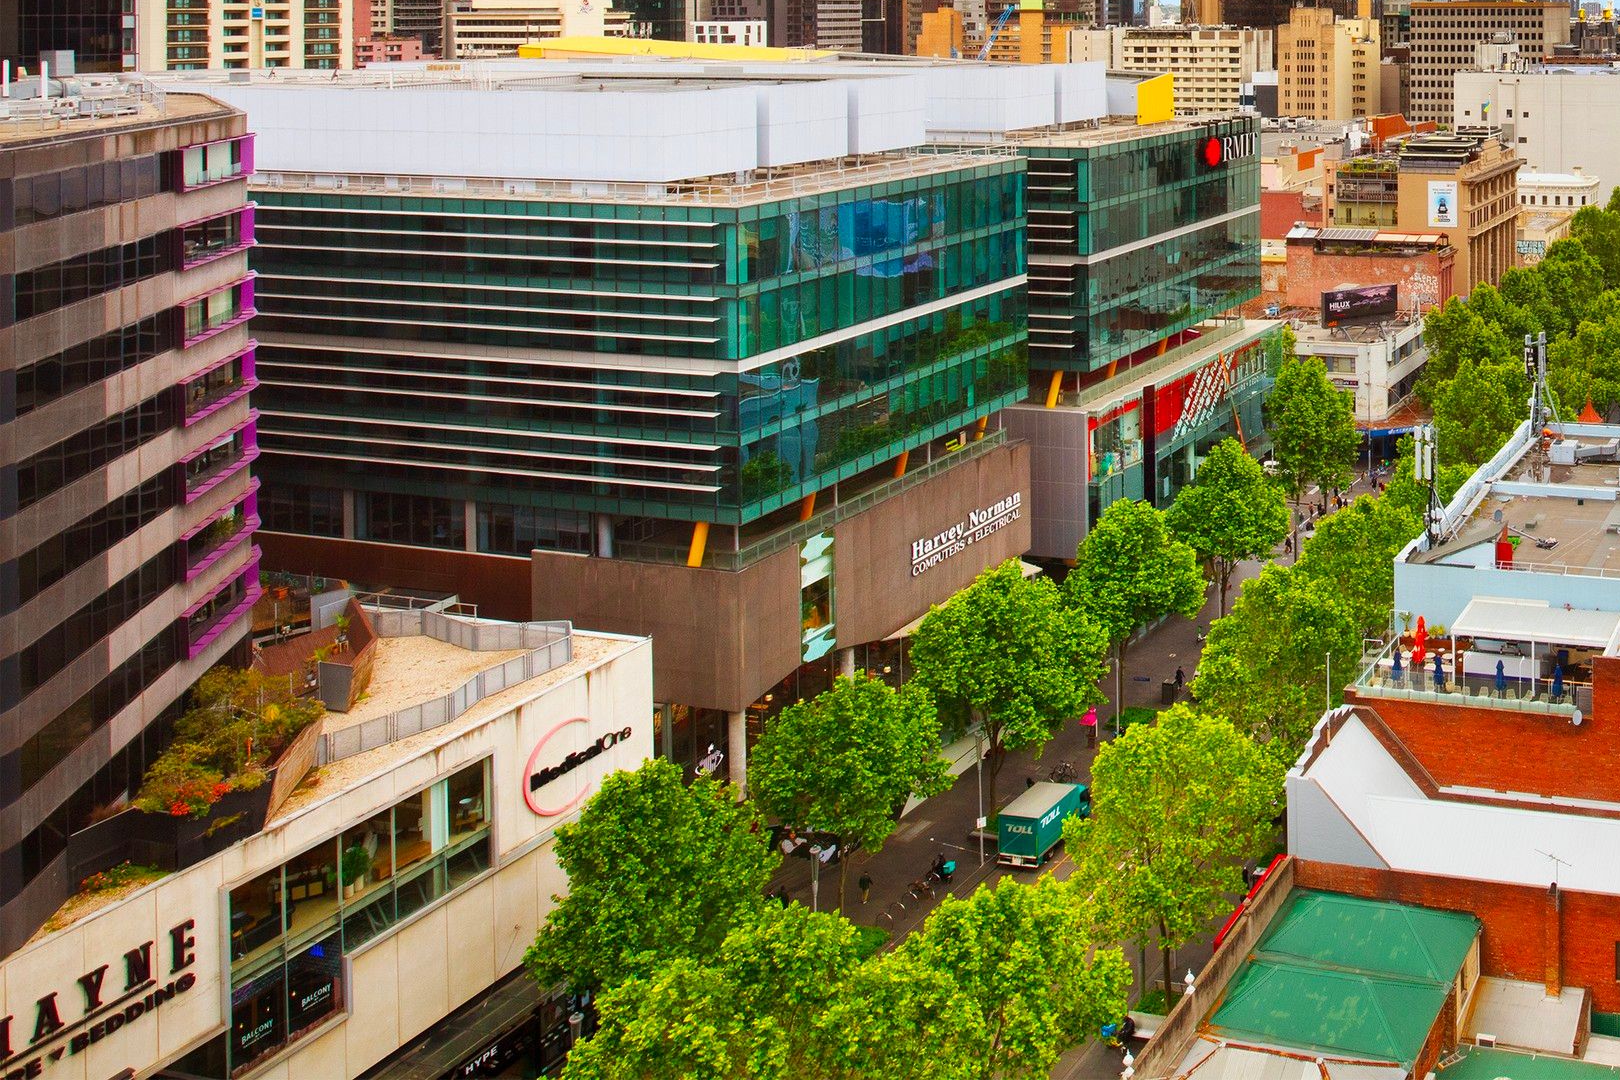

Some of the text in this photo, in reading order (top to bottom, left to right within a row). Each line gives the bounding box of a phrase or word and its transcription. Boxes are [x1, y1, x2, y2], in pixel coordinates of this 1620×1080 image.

[1222, 131, 1257, 162] RMIT
[1329, 300, 1351, 310] HILUX
[912, 492, 1021, 560] Harvey Norman
[912, 509, 1021, 576] COMPUTERS & ELECTRICAL
[530, 726, 632, 792] MedicalOne
[1006, 823, 1034, 835] TOLL
[1040, 805, 1061, 829] TOLL
[301, 982, 332, 1008] BALCONY
[70, 973, 196, 1056] BEDDING
[241, 1018, 274, 1045] BALCONY
[465, 1045, 498, 1075] HYPE
